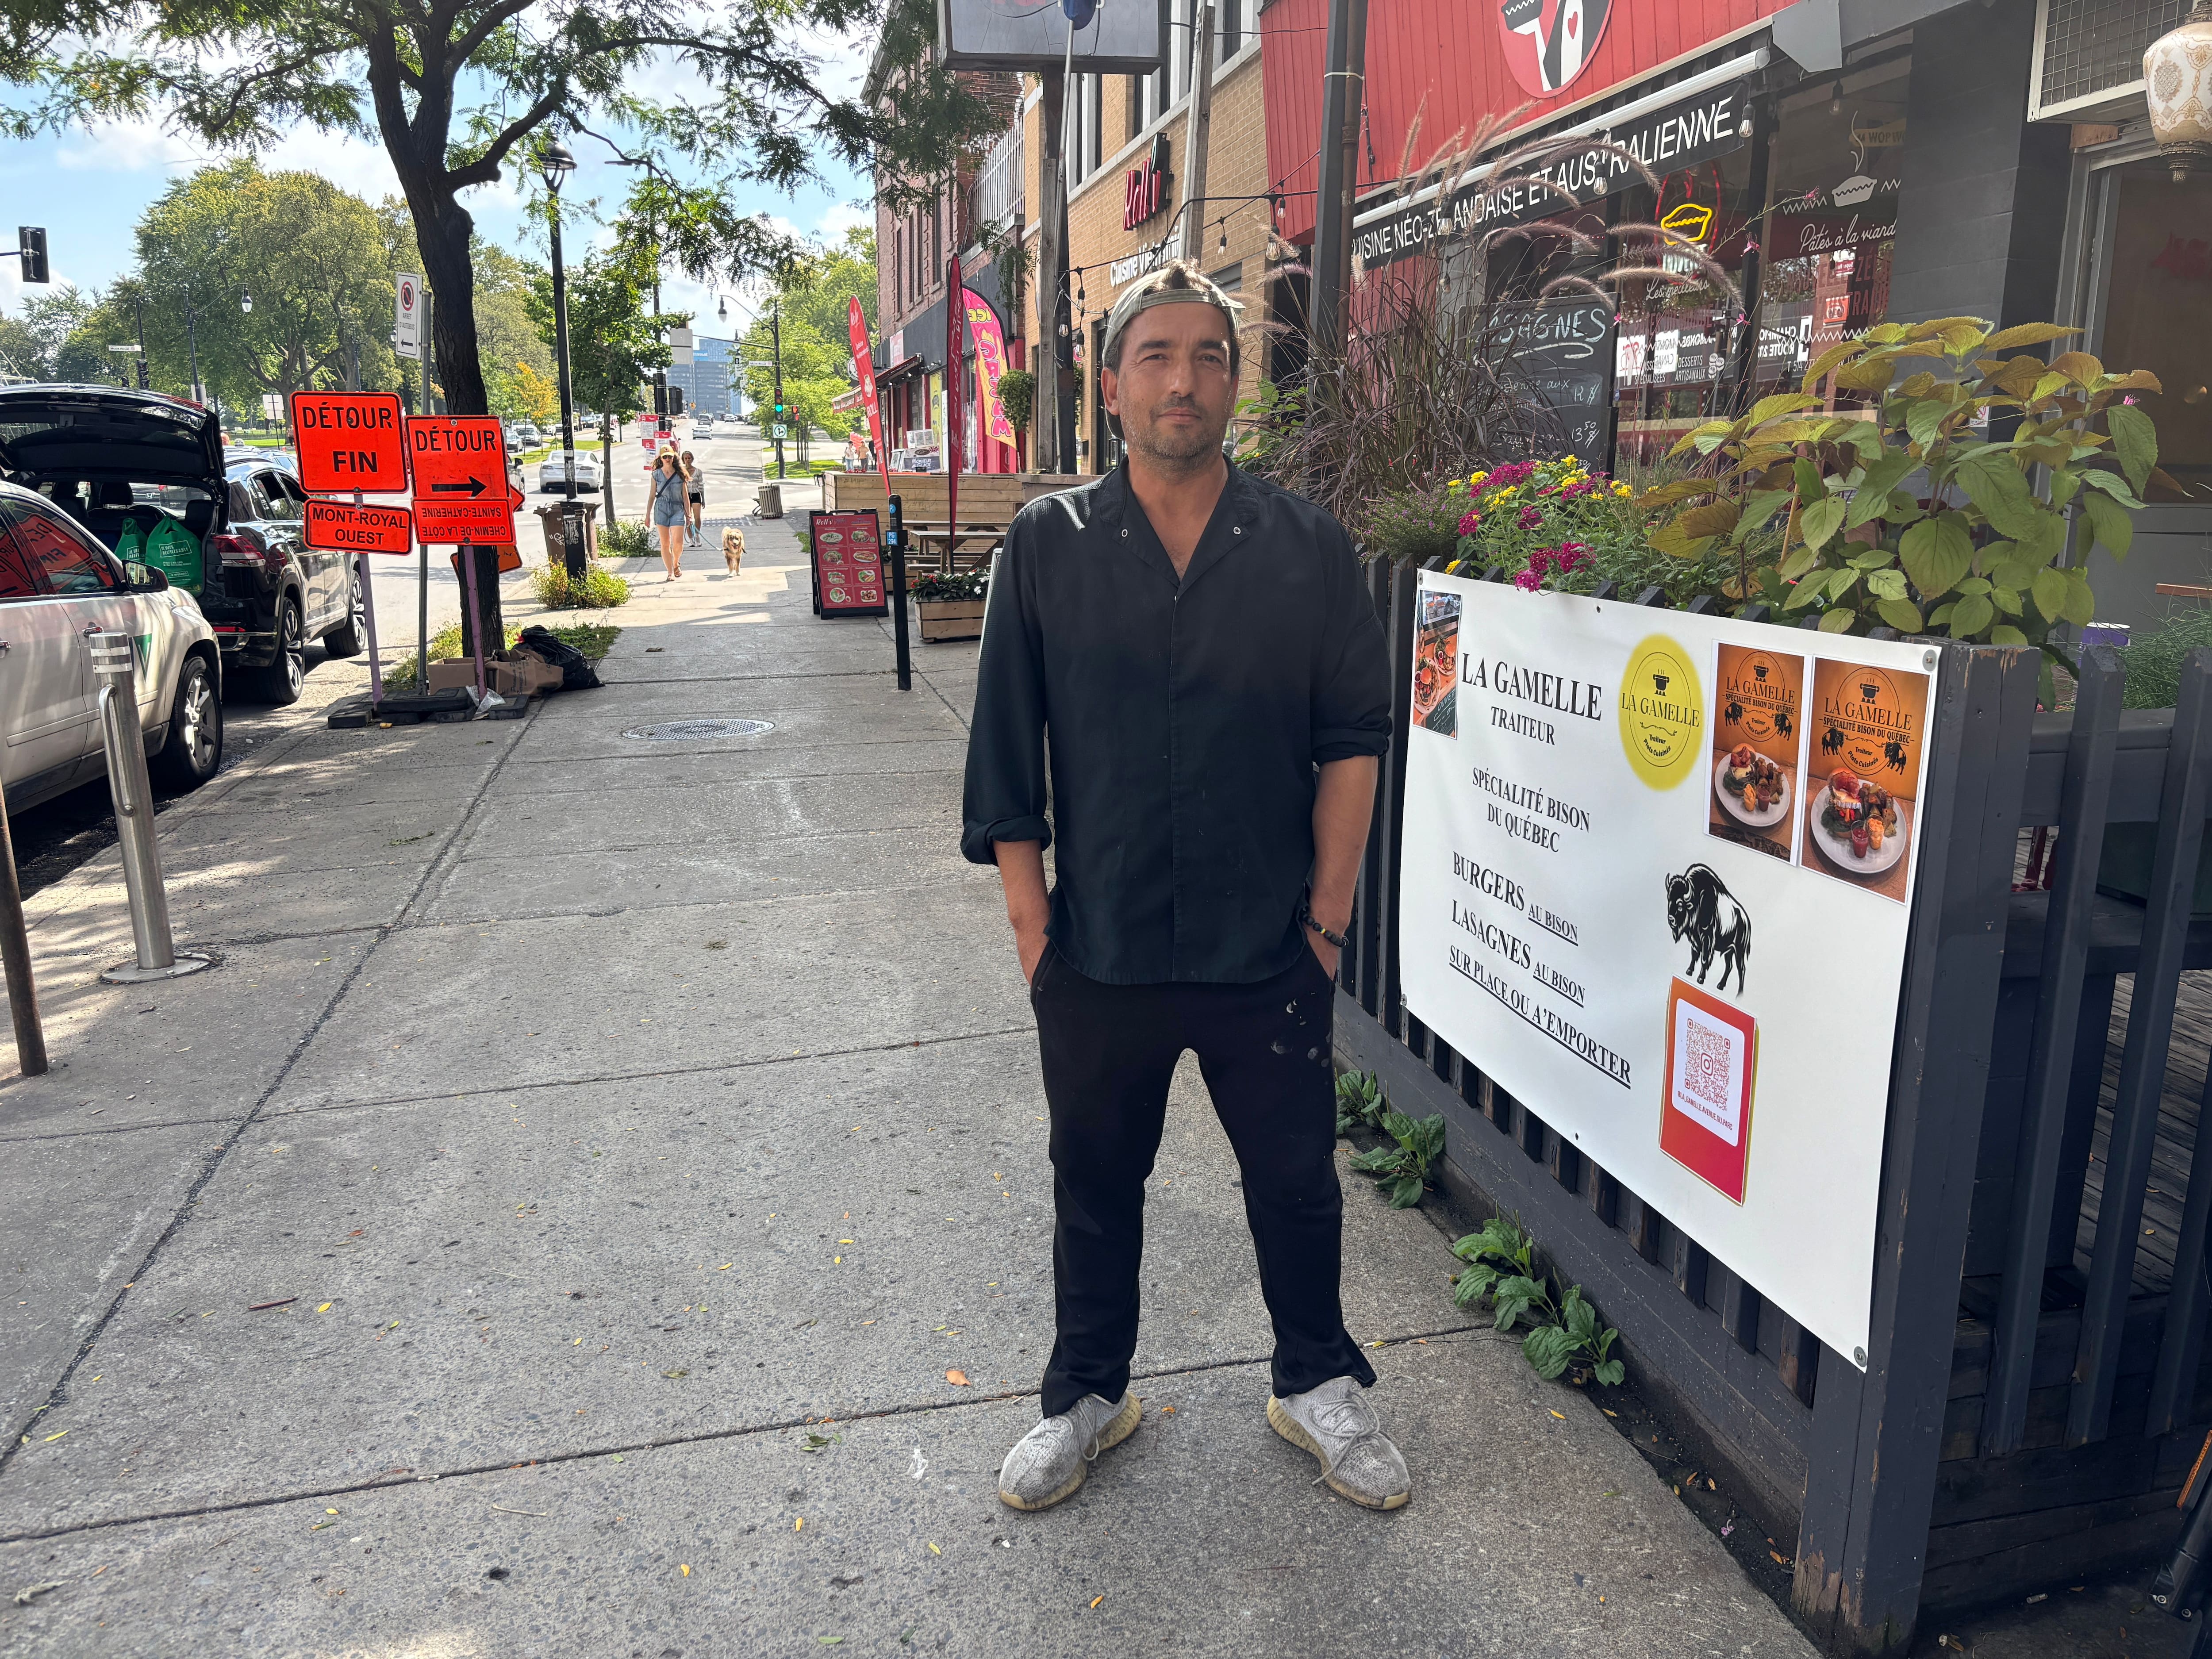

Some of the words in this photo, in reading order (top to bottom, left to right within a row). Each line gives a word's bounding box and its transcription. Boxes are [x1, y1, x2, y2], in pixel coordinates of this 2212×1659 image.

[1352, 226, 1392, 260] UISINE
[1394, 186, 1523, 250] NÉO-ZANDAISE
[1529, 166, 1552, 205] ET
[1555, 96, 1733, 197] AUSRALIENNE
[1800, 223, 1832, 253] Pâtés
[1835, 227, 1844, 246] à
[1846, 213, 1859, 244] la
[1861, 218, 1897, 241] viand
[1110, 253, 1138, 287] Cuisine
[1471, 308, 1606, 343] ASAGNES
[1678, 355, 1703, 368] DESSERTS
[1793, 360, 1803, 372] 514
[1675, 369, 1705, 381] ARTISANAUX
[302, 401, 393, 429] DÉTOUR
[415, 426, 496, 451] DÉTOUR
[333, 451, 378, 472] FIN
[312, 507, 407, 529] MONT-ROYAL
[422, 507, 501, 518] SAINTE-CATHERINE
[335, 529, 384, 545] OUEST
[423, 526, 445, 538] CÔTE
[447, 526, 458, 536] LA
[461, 526, 506, 536] CHEMIN-DE
[1462, 653, 1487, 689] LA
[1494, 661, 1602, 721] GAMELLE
[1727, 677, 1740, 692] LA
[1743, 680, 1795, 704] GAMELLE
[1621, 692, 1637, 712] LA
[1640, 697, 1700, 727] GAMELLE
[1725, 692, 1751, 705] SPÉCIALITÉ
[1752, 698, 1767, 708] BISON
[1776, 703, 1794, 714] QUÉBEC
[1824, 697, 1841, 715] LA
[1845, 702, 1912, 730] GAMELLE
[1490, 706, 1555, 745] TRAITEUR
[1746, 721, 1755, 733] Plats
[1755, 726, 1770, 735] Cuisinés
[1823, 716, 1855, 731] SPÉCIALITÉ
[1857, 724, 1875, 736] BISON
[1877, 729, 1885, 738] DU
[1887, 730, 1910, 744] QUÉBEC
[1643, 738, 1653, 754] Plats
[1653, 745, 1671, 757] Cuisinés
[1649, 734, 1666, 744] Traiteur
[1855, 746, 1873, 756] Traiteur
[1847, 750, 1858, 765] Plats
[1859, 757, 1878, 768] Cuisinés
[1472, 767, 1544, 814] SPÉCIALITÉ
[1546, 797, 1590, 833] BISON
[1487, 803, 1502, 827] DU
[1505, 813, 1560, 853] QUÉBEC
[1453, 851, 1525, 911] BURGERS
[1528, 902, 1542, 922] AU
[1545, 910, 1578, 941] BISON
[1451, 899, 1531, 969] LASAGNES
[1533, 961, 1549, 981] AU
[1551, 969, 1586, 1003] BISON
[1449, 945, 1471, 974] SUR
[1474, 960, 1508, 1002] PLACE
[1510, 989, 1530, 1015] OU
[1532, 1003, 1631, 1084] A'EMPORTER
